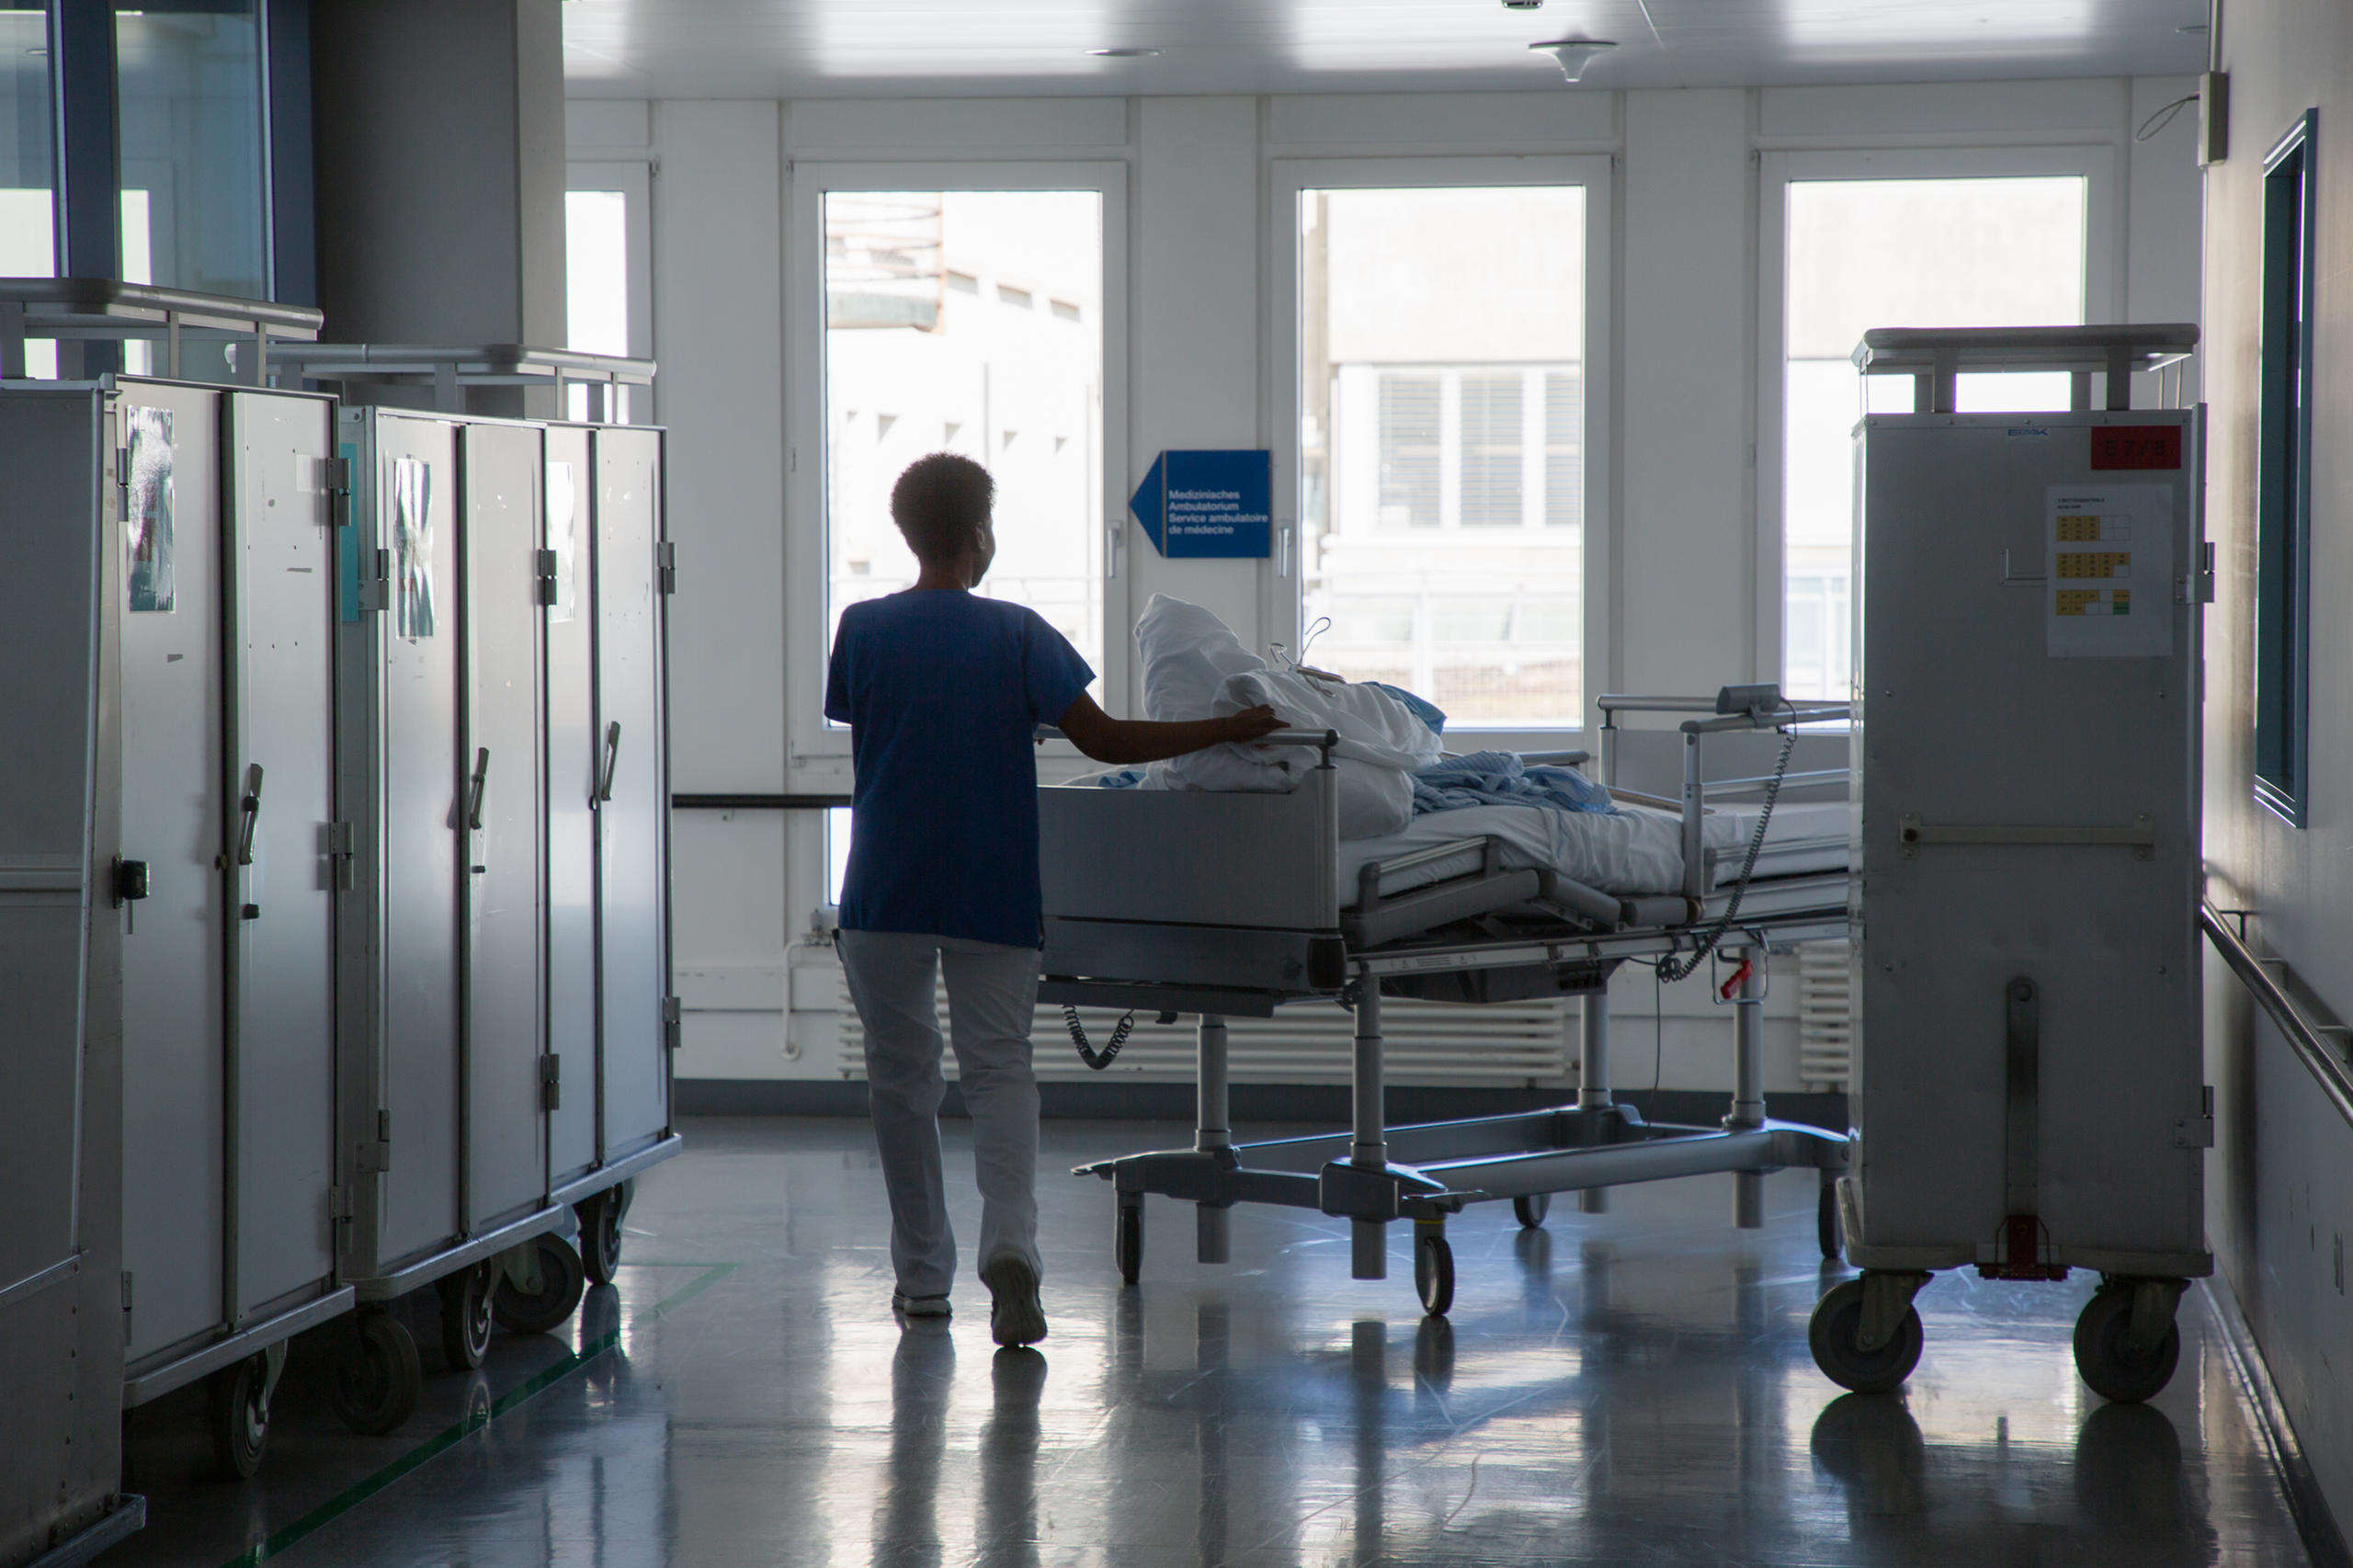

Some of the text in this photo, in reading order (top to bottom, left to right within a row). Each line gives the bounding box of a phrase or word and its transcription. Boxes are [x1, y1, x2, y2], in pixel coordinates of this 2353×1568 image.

[1168, 490, 1240, 500] Medizinisches
[1168, 501, 1239, 511] Ambulatorium
[1168, 513, 1269, 523] Service ambulatoire
[1168, 525, 1234, 535] de médecine
